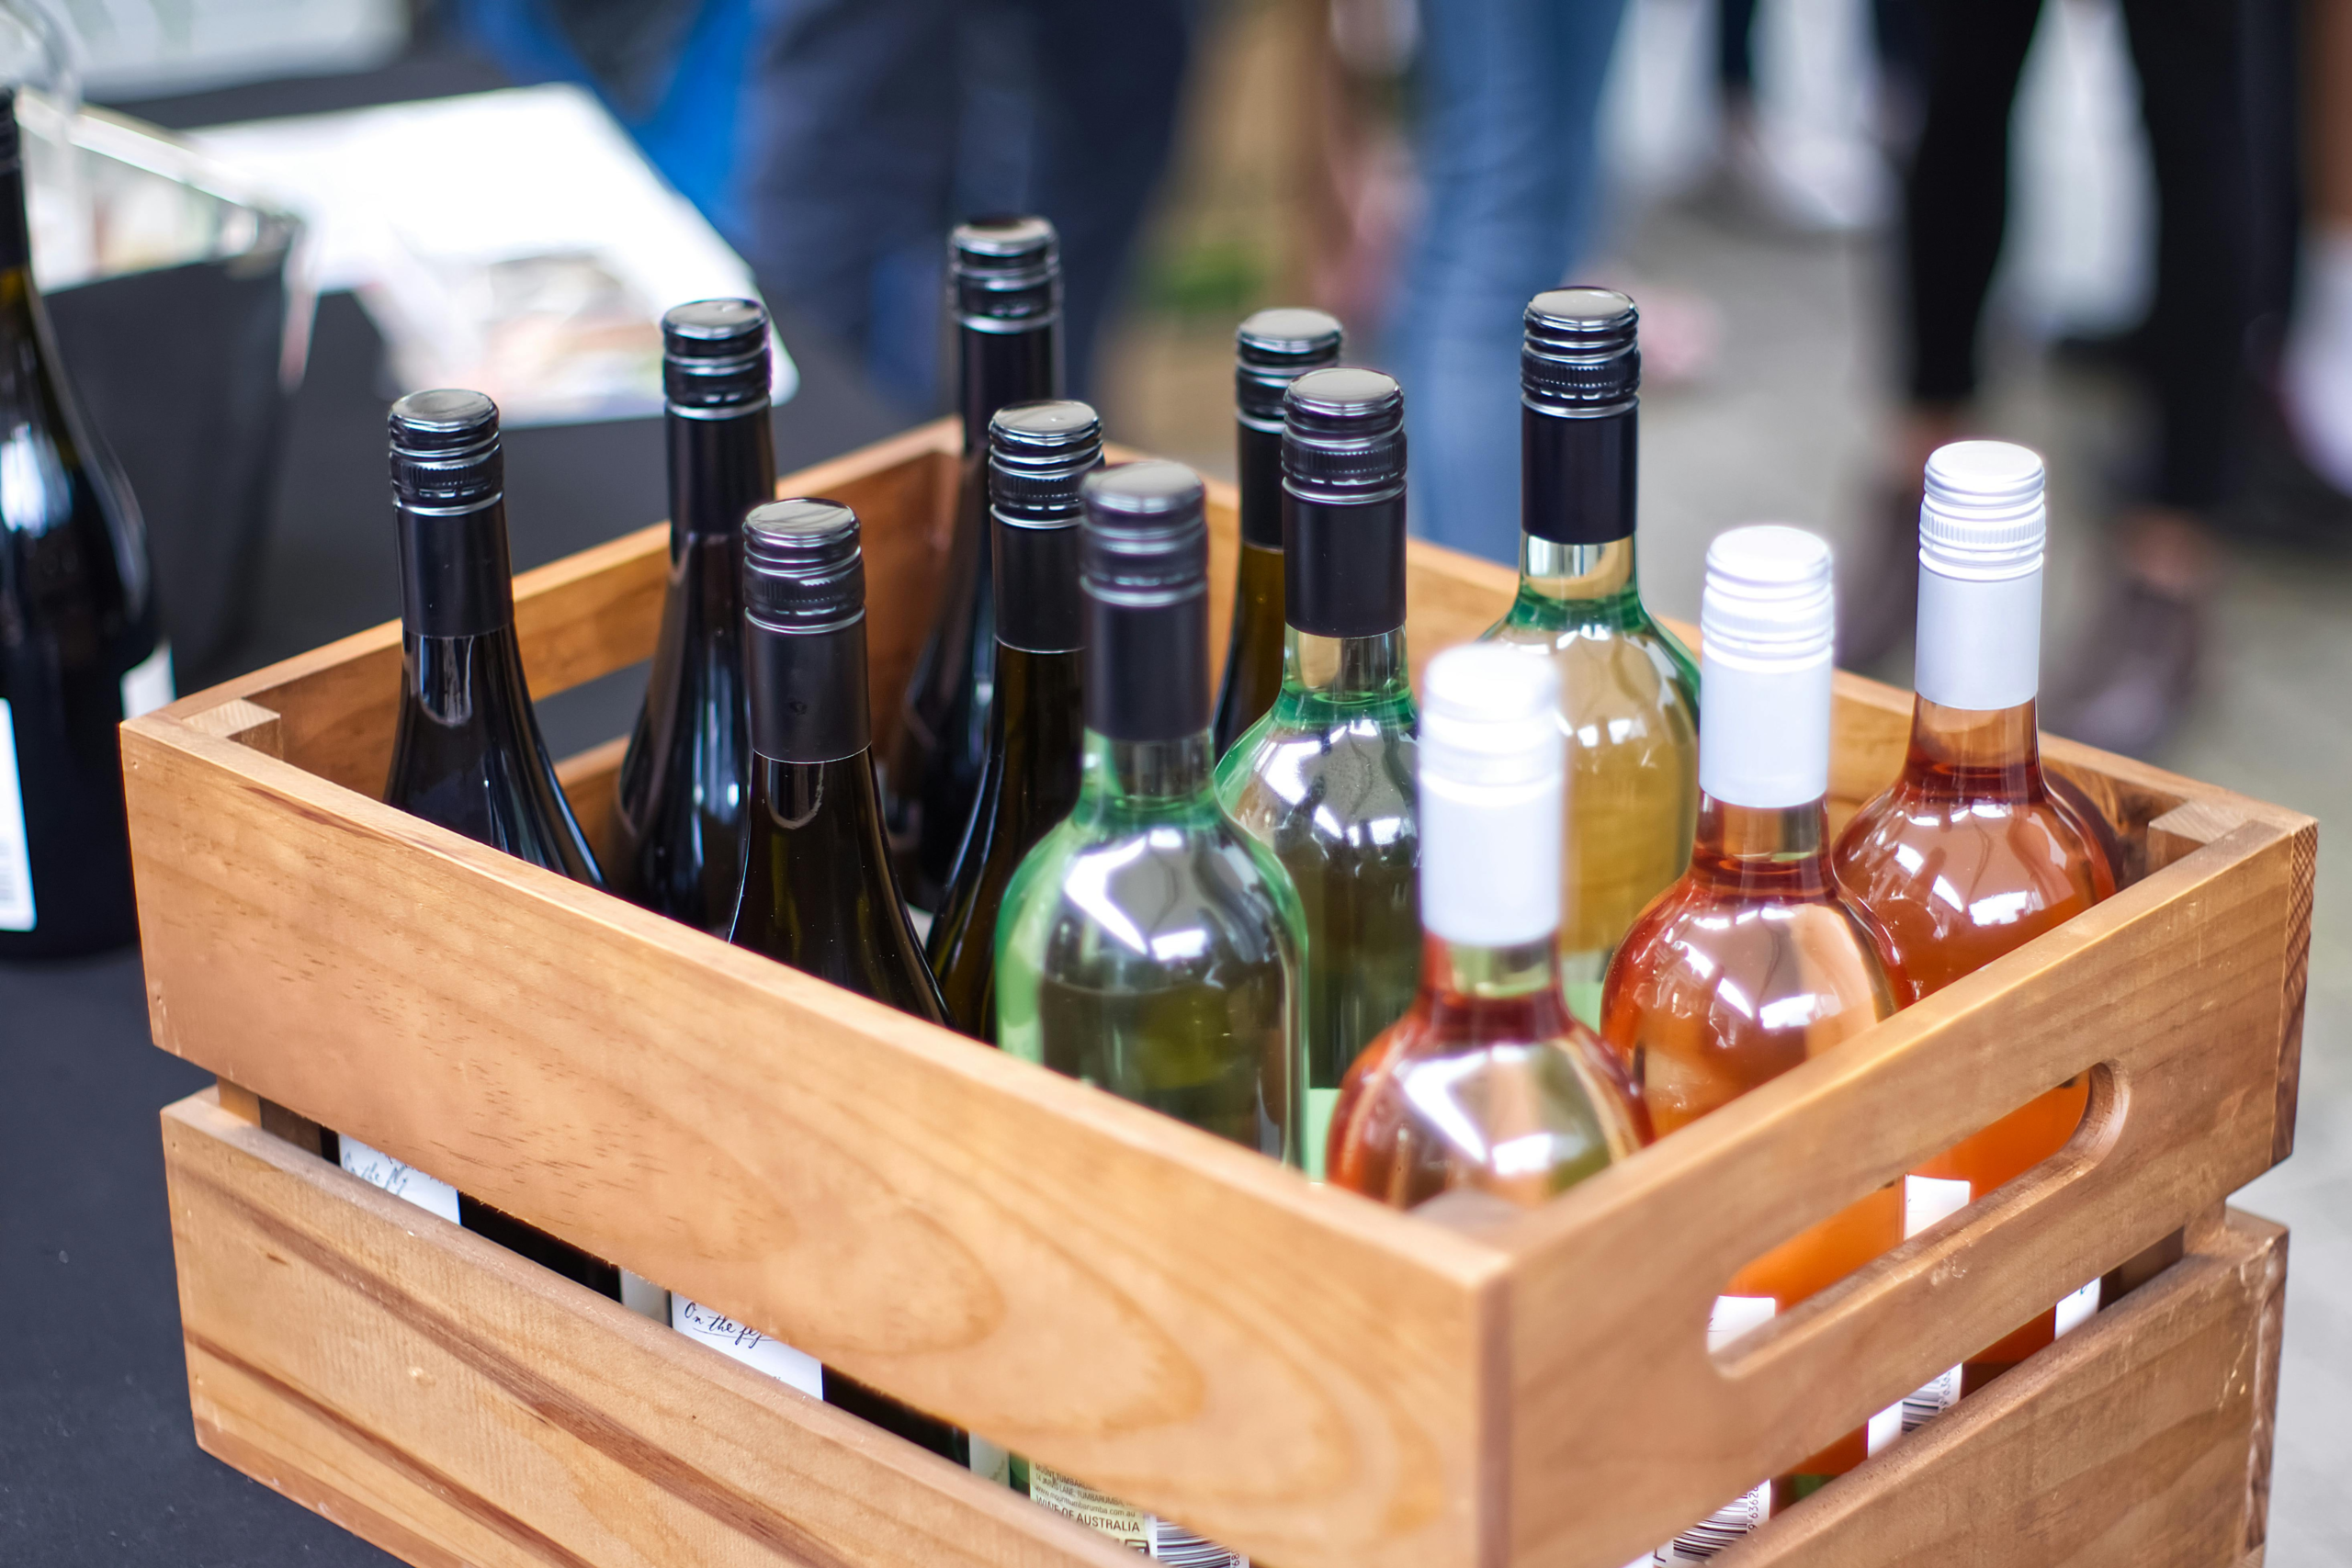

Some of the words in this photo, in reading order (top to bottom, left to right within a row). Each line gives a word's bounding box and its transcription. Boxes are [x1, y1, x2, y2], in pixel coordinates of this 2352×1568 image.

[684, 1301, 704, 1325] On
[707, 1314, 736, 1334] the
[1056, 1472, 1101, 1492] TUMBARU
[1035, 1494, 1059, 1514] WINE
[1060, 1506, 1075, 1520] OF
[1076, 1512, 1140, 1533] AUSTRALIA
